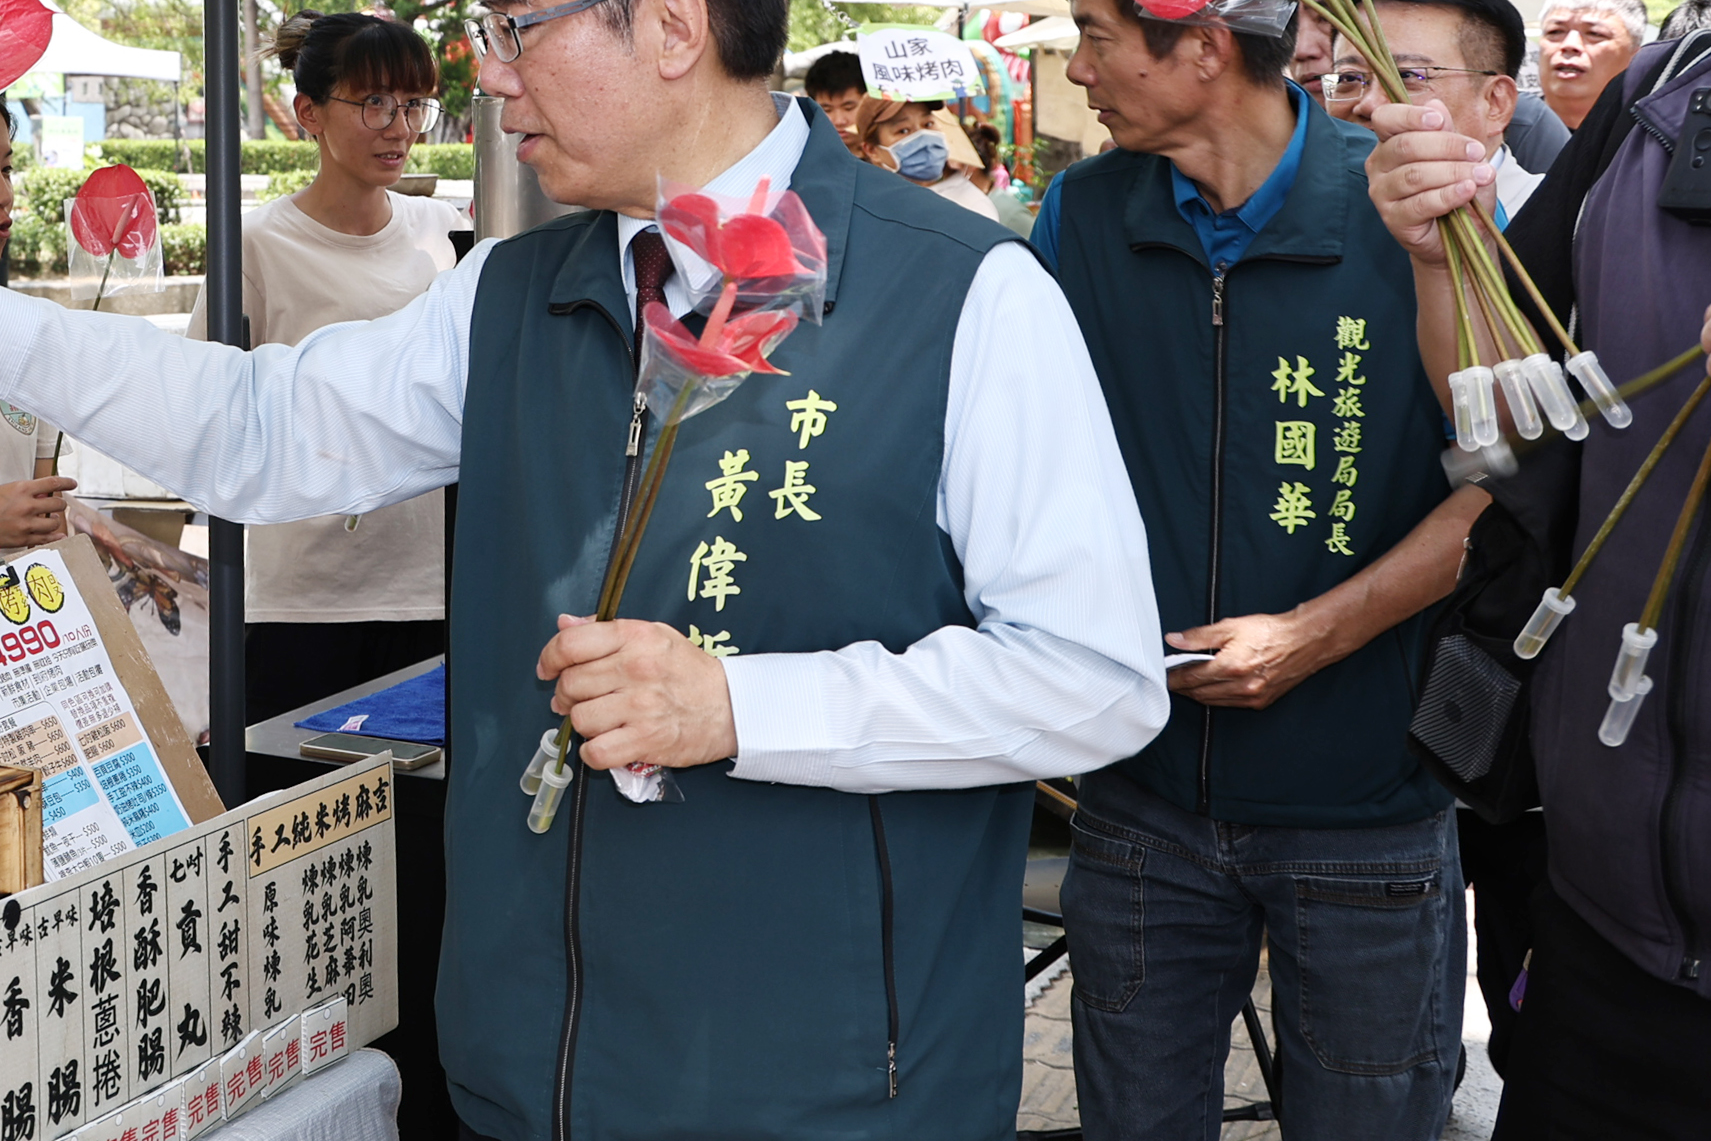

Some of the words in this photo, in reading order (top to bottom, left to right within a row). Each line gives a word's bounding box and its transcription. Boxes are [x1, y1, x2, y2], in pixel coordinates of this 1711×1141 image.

[883, 36, 934, 61] 山家
[872, 58, 965, 84] 風味烤肉
[768, 389, 838, 523] 市長
[1268, 354, 1327, 535] 林國華
[1324, 314, 1371, 557] 觀光旅遊局局長
[40, 715, 59, 730] $650
[46, 728, 64, 743] $650
[109, 718, 127, 733] $600
[53, 741, 71, 756] $600
[98, 738, 115, 753] $600
[119, 751, 136, 767] $300
[66, 766, 84, 781] $400
[73, 779, 91, 794] $350
[127, 764, 143, 779] $350
[48, 806, 67, 821] $450
[82, 821, 100, 837] $500
[249, 776, 391, 868] 手工純米烤麻吉
[90, 834, 108, 850] $500
[109, 840, 128, 856] $500
[169, 845, 204, 884] 七吋
[37, 905, 80, 940] 古早味
[217, 830, 242, 1045] 手工甜不辣
[301, 863, 322, 1000] 煉乳花生
[319, 855, 341, 989] 煉乳芝麻
[356, 840, 374, 1007] 煉乳奧利奧
[262, 881, 282, 1020] 原味煉乳
[88, 880, 122, 1108] 培根蔥捲
[133, 865, 166, 1082] 香酥肥腸
[175, 900, 208, 1062] 貢丸
[46, 956, 83, 1128] 米腸
[309, 1020, 347, 1063] 完售
[225, 1054, 264, 1107] 完售
[266, 1037, 301, 1088] 完售
[187, 1081, 222, 1130] 完售
